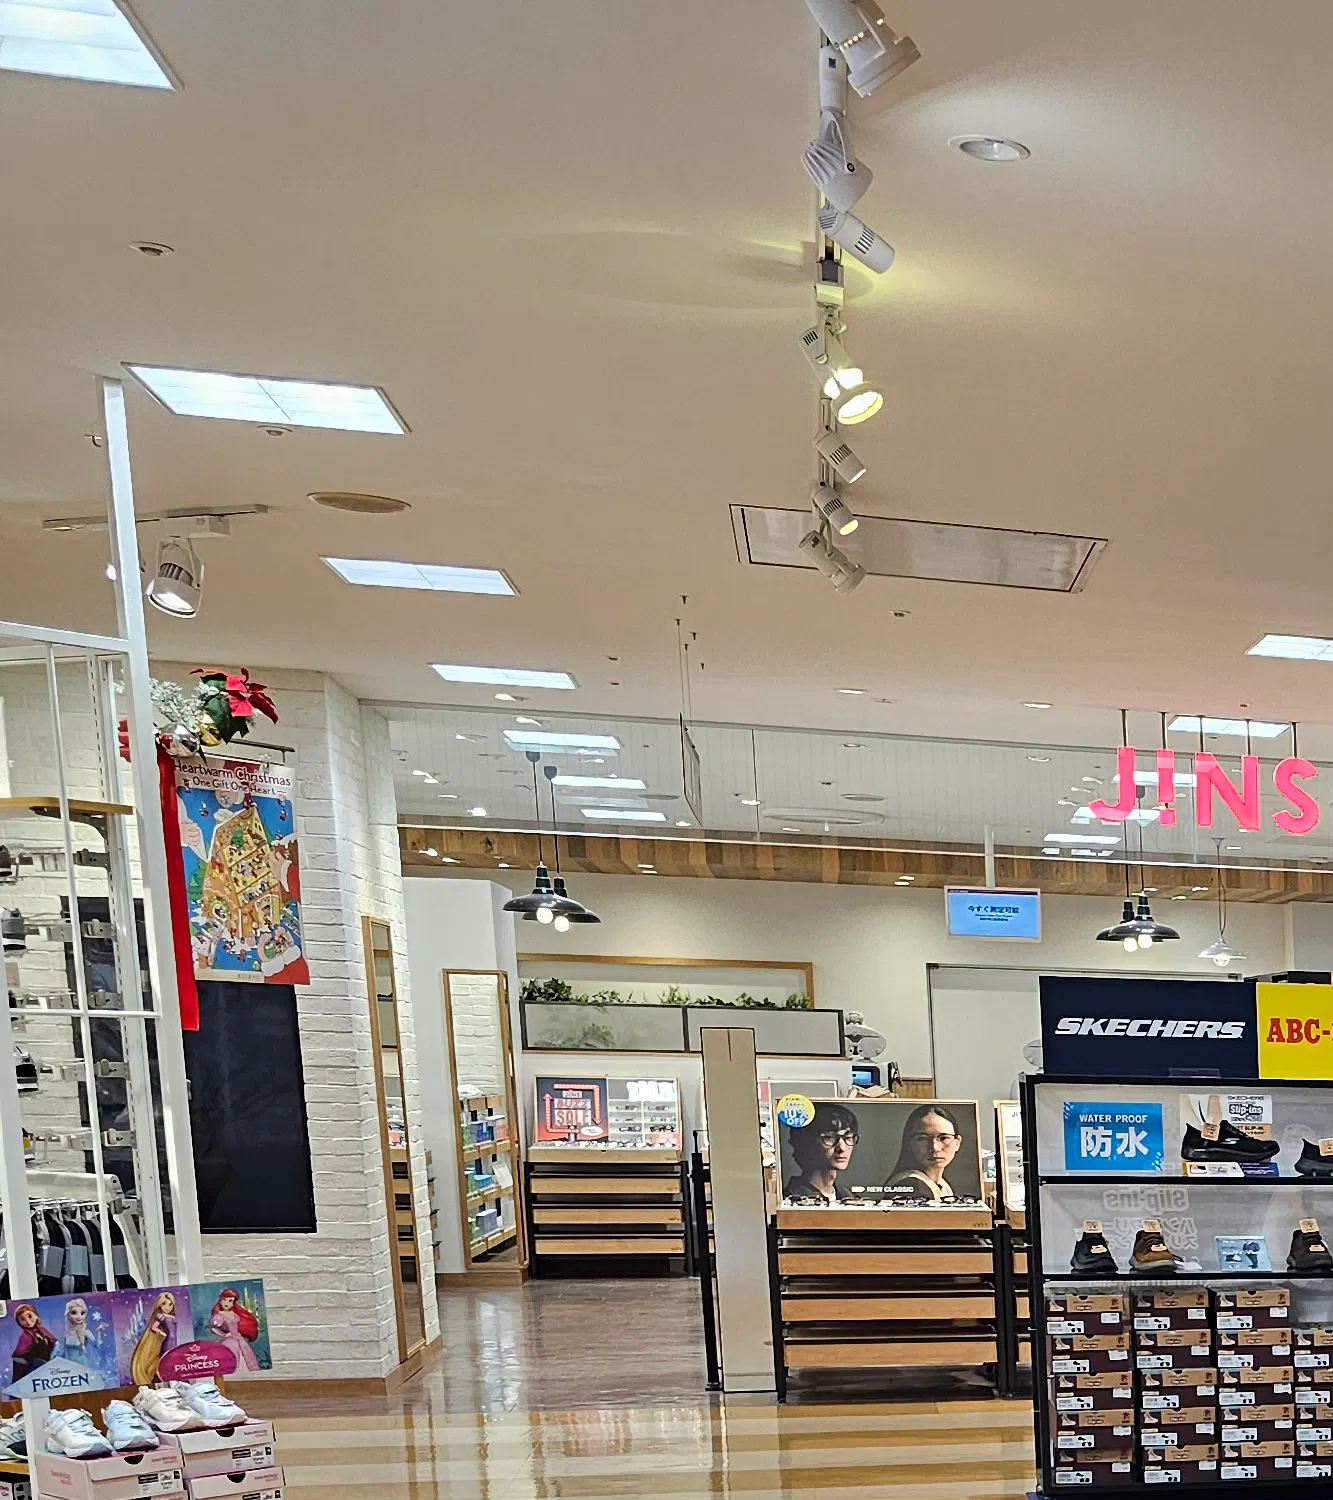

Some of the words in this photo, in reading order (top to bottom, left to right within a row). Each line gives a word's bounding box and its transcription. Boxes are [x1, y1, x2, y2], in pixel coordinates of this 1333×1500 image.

[174, 759, 233, 779] Heartwarm
[235, 767, 291, 787] Christmas
[192, 776, 211, 787] One
[212, 778, 230, 790] Gift
[231, 781, 248, 793] One
[250, 784, 276, 796] Heart
[1054, 1017, 1246, 1039] SKECHERS
[786, 1117, 807, 1127] OFF
[1079, 1114, 1113, 1124] WATER
[1116, 1114, 1148, 1124] PROOF
[1080, 1126, 1149, 1158] 防水
[174, 1359, 219, 1372] PRINCESS
[32, 1372, 90, 1393] FROZEN
